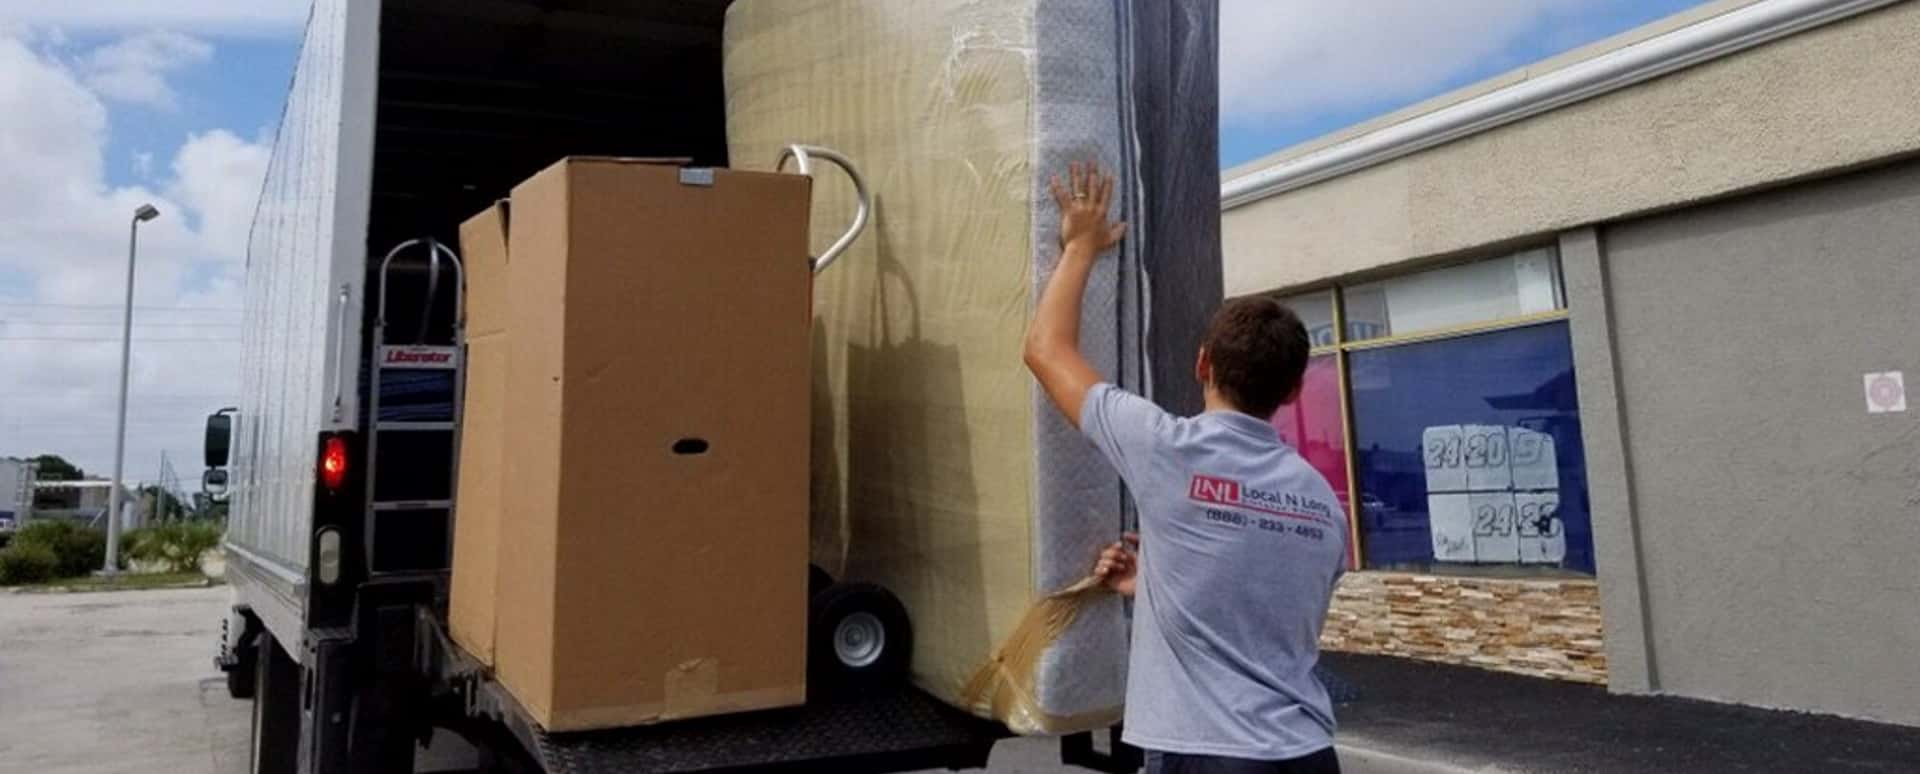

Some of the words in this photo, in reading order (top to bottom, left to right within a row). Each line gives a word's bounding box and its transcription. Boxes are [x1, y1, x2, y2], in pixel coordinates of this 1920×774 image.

[1427, 434, 1461, 468] 24
[1465, 432, 1505, 468] 20
[1192, 477, 1238, 503] LNL
[1242, 485, 1282, 505] Local
[1285, 493, 1298, 506] N
[1301, 496, 1331, 518] Long
[1475, 504, 1513, 537] 24
